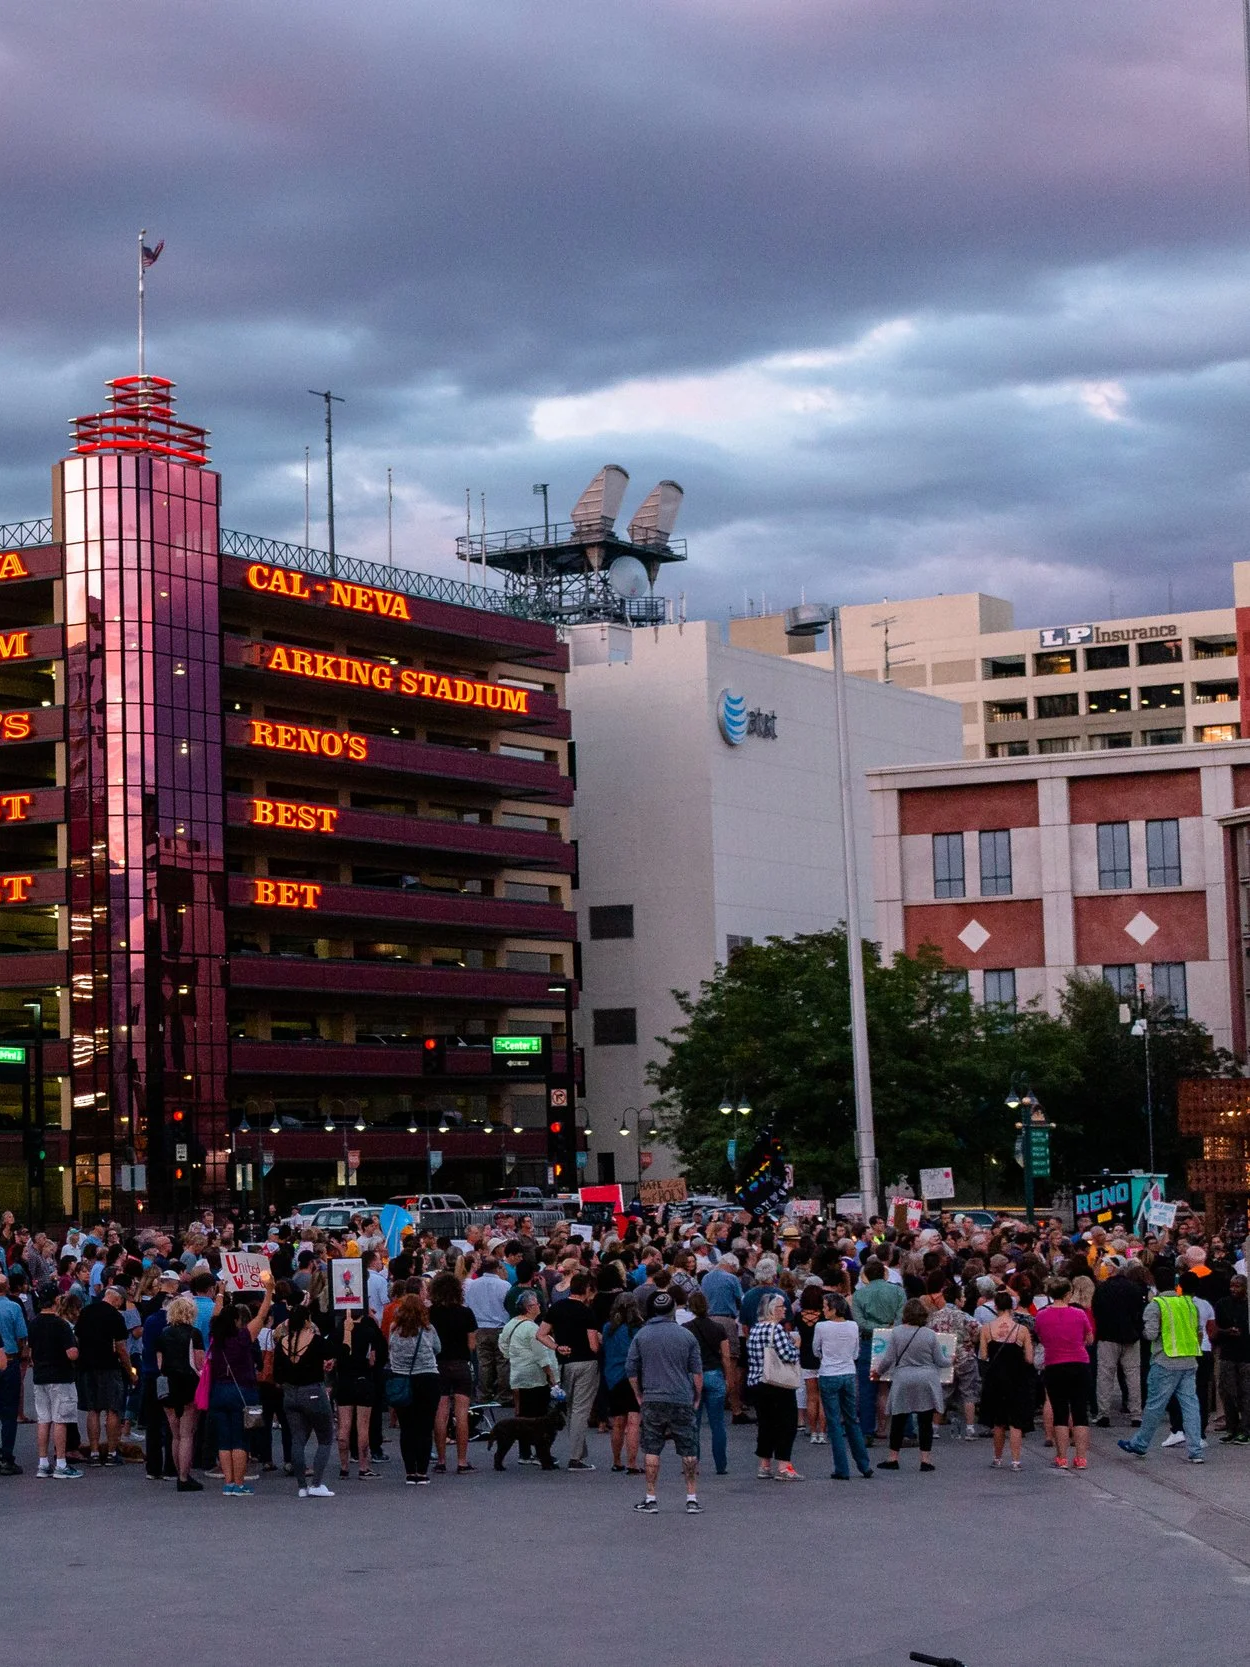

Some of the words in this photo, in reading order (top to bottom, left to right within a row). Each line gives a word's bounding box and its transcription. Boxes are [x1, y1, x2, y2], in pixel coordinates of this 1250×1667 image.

[247, 565, 310, 599] CAL
[329, 581, 412, 620] NEVA
[1094, 624, 1177, 644] Insurance
[400, 670, 530, 713] STADIUM
[251, 720, 367, 761] RENO'S
[252, 799, 338, 833] BEST
[253, 880, 322, 909] BET
[505, 1040, 530, 1050] Center
[1076, 1182, 1129, 1214] RENO
